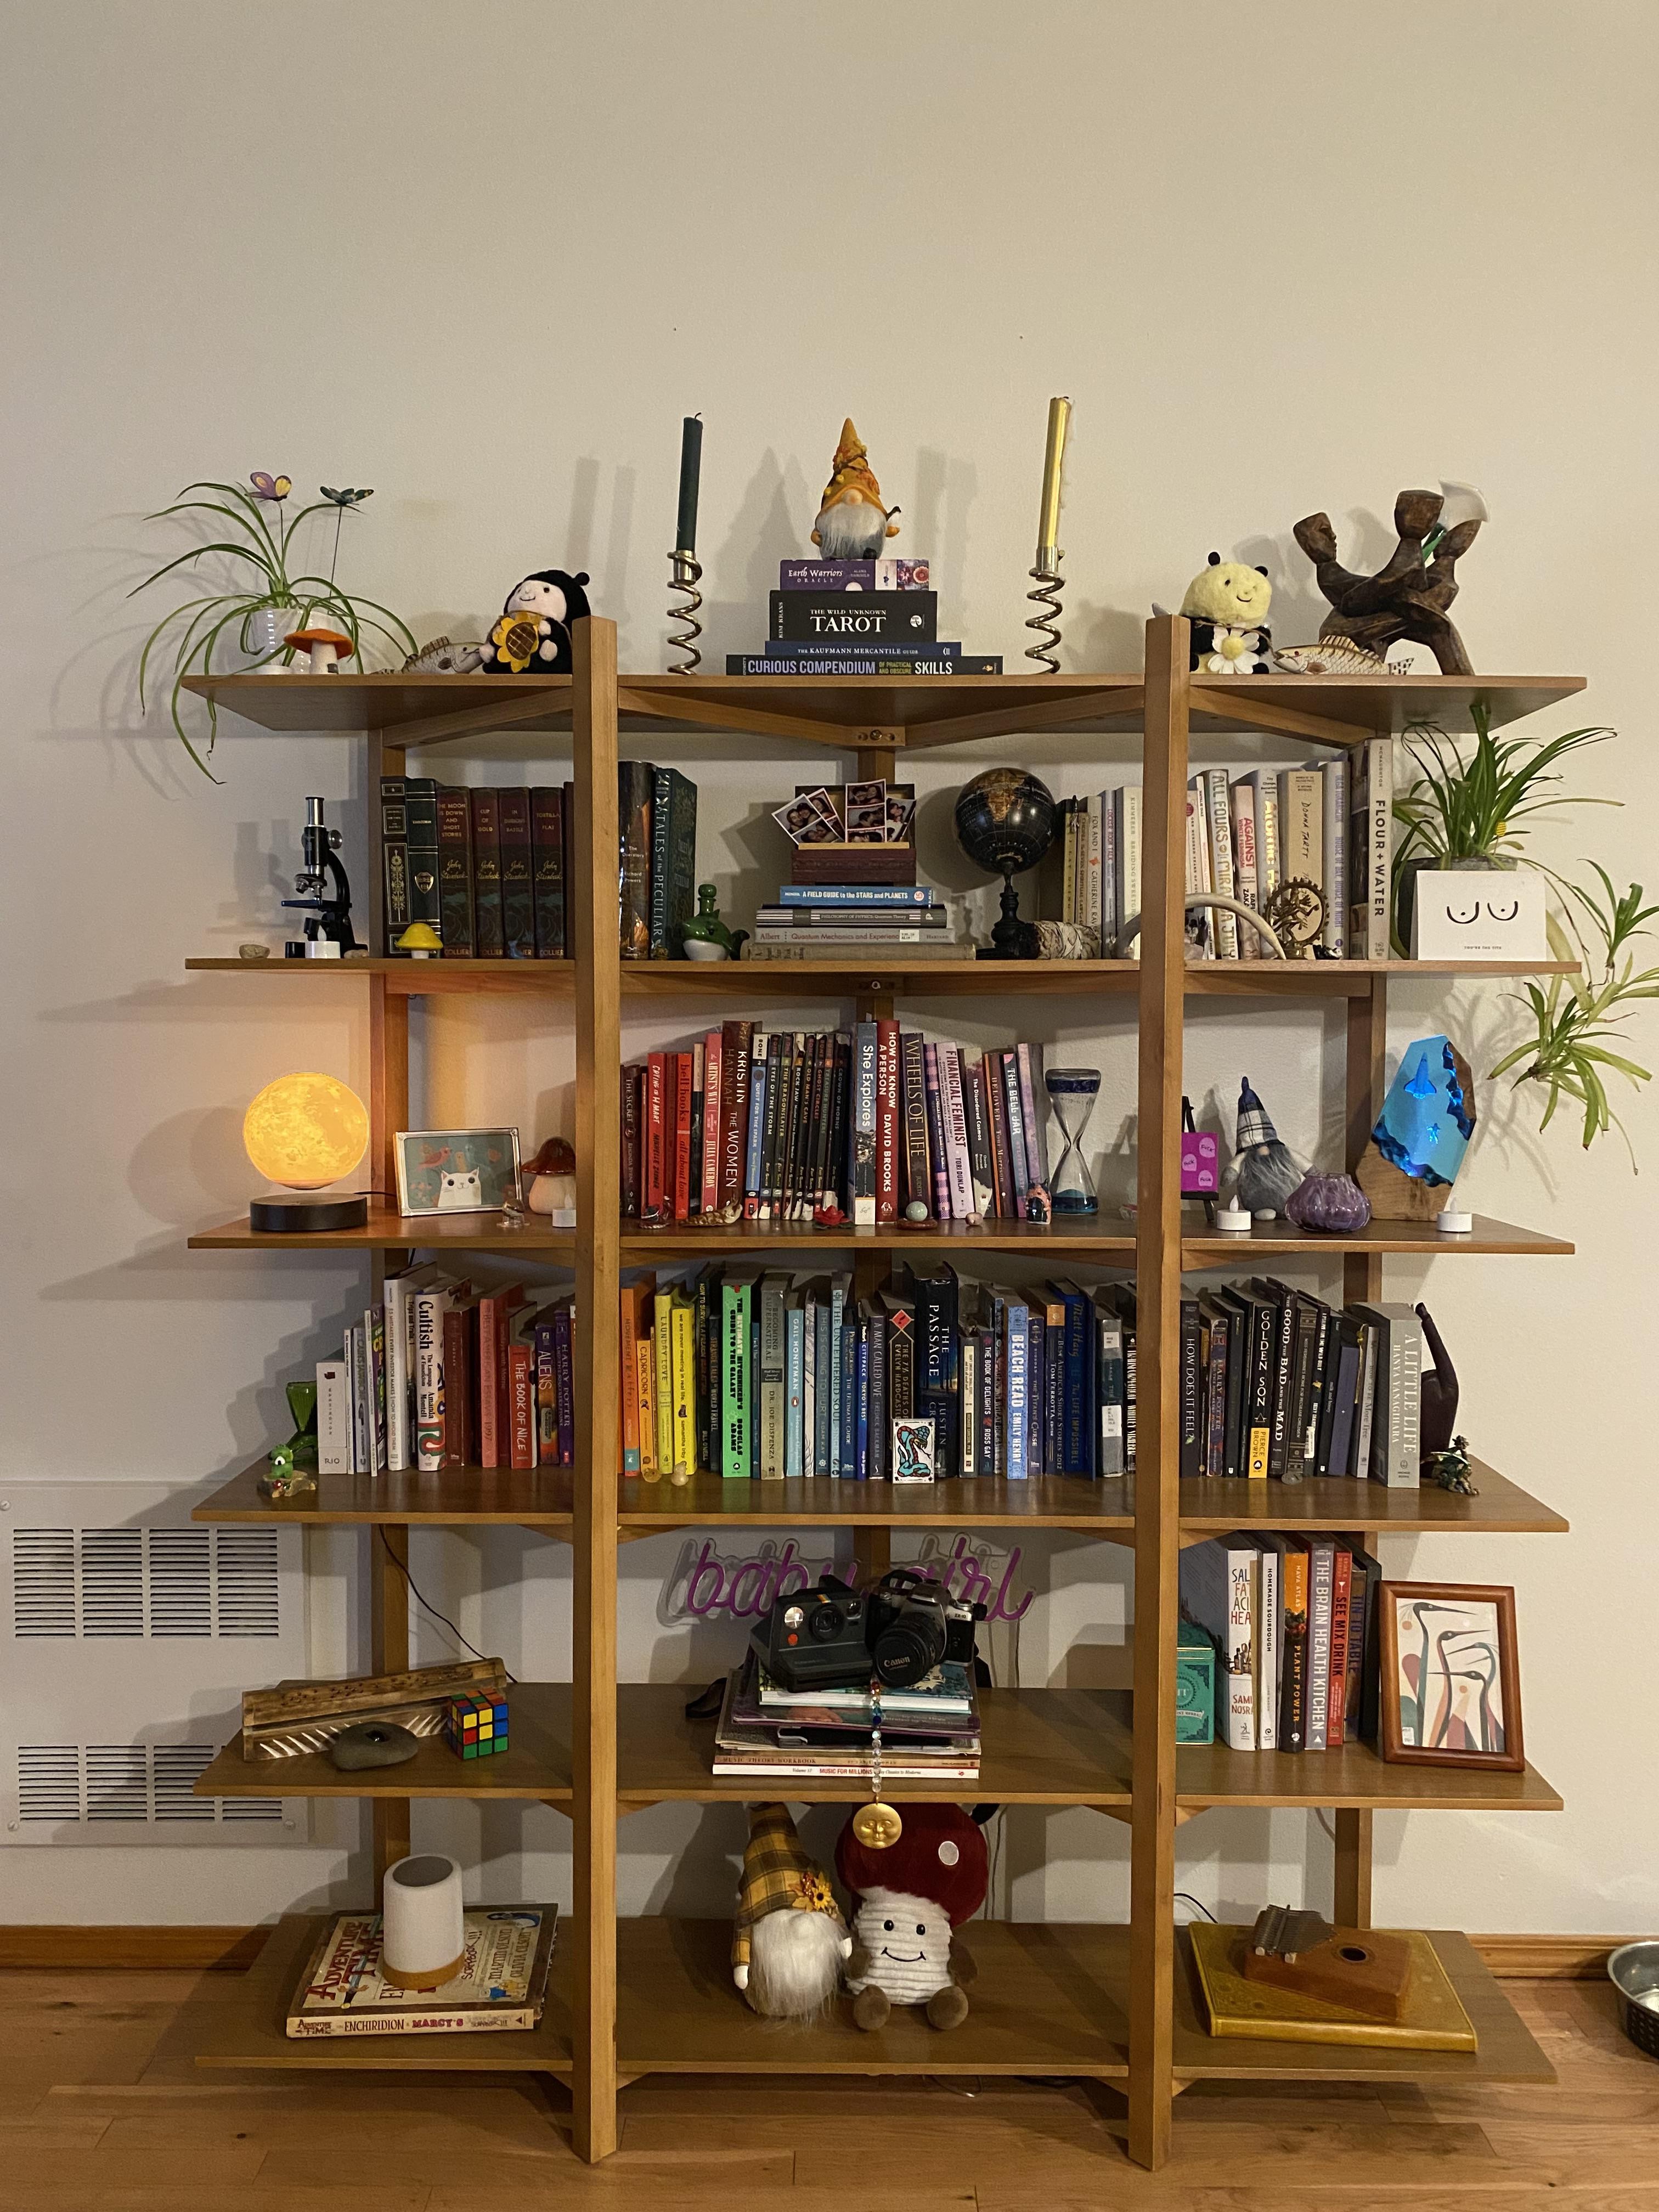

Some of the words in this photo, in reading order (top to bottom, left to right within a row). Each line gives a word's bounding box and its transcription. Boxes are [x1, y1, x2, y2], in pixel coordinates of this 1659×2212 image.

[788, 567, 808, 577] Earth
[810, 568, 843, 577] Warriors
[810, 617, 886, 632] TAROT
[748, 660, 797, 673] CURIOUS
[800, 661, 875, 674] COMPENDIUM
[915, 662, 952, 674] SKILLS
[1212, 775, 1226, 798] ALL
[1215, 800, 1228, 843] FOURS
[1301, 802, 1311, 828] DONNA
[1375, 800, 1386, 849] FLOUR
[655, 815, 665, 853] TALES
[1245, 817, 1255, 869] AGAINST
[1301, 831, 1310, 859] TARTT
[1375, 864, 1385, 917] WATER
[653, 874, 664, 936] PECULIAR
[861, 1045, 874, 1069] She
[888, 1031, 897, 1057] HOW
[707, 1062, 719, 1090] ARTIST'S
[723, 1048, 735, 1105] HANNAH
[736, 1051, 747, 1103] KRISTIN
[879, 1054, 887, 1096] PERSON
[888, 1059, 896, 1073] TO
[905, 1039, 923, 1099] WHEELS
[945, 1050, 962, 1101] FINANCIAL
[1007, 1067, 1017, 1088] THE
[707, 1092, 718, 1105] WAY
[770, 1085, 775, 1093] OF
[860, 1073, 873, 1127] Explores
[888, 1075, 896, 1109] KNOW
[1009, 1090, 1019, 1112] BELL
[729, 1111, 738, 1128] THE
[909, 1102, 924, 1124] OF
[951, 1103, 966, 1148] FEMINIST
[1012, 1116, 1022, 1135] JAR
[883, 1114, 892, 1147] DAVID
[910, 1129, 926, 1158] LIFE
[706, 1140, 716, 1158] JULIA
[725, 1130, 740, 1187] WOMEN
[706, 1159, 715, 1189] CAMERON
[883, 1150, 891, 1192] BROOKS
[419, 1300, 434, 1350] Cultish
[679, 1313, 683, 1322] we
[873, 1330, 882, 1348] MAN
[928, 1305, 939, 1377] PASSAGE
[941, 1326, 950, 1353] THE
[1186, 1339, 1195, 1365] HOW
[1259, 1310, 1271, 1370] GOLDEN
[1404, 1334, 1418, 1344] A
[873, 1351, 882, 1379] CALLED
[1012, 1334, 1025, 1373] BEACH
[515, 1361, 527, 1380] THE
[538, 1350, 552, 1390] ALIENS
[639, 1346, 648, 1394] CAPRICORN
[1186, 1368, 1195, 1395] DOES
[1404, 1350, 1418, 1410] LITTLE
[516, 1383, 527, 1409] BOOK
[872, 1381, 882, 1397] OVE
[1011, 1376, 1025, 1408] READ
[1186, 1397, 1195, 1408] IT
[1256, 1376, 1267, 1407] SON
[516, 1411, 526, 1425] OF
[1012, 1412, 1022, 1436] EMILY
[1186, 1410, 1195, 1438] FEEL?
[1392, 1380, 1401, 1443] YANAGIHARA
[517, 1427, 528, 1451] NICE
[1403, 1415, 1418, 1453] LIFE
[1012, 1438, 1022, 1463] HENRY
[1316, 1560, 1330, 1582] THE
[1315, 1585, 1329, 1625] BRAIN
[1335, 1596, 1347, 1616] SEE
[1334, 1619, 1346, 1639] MIX
[884, 1656, 911, 1668] Canon
[1314, 1628, 1328, 1675] HEALTH
[1332, 1643, 1345, 1677] DRINK
[1233, 1695, 1252, 1704] SAMI
[1312, 1678, 1325, 1729] KITCHEN
[345, 2019, 404, 2032] ENCHIRIDION
[412, 2018, 464, 2029] MARCY'S
